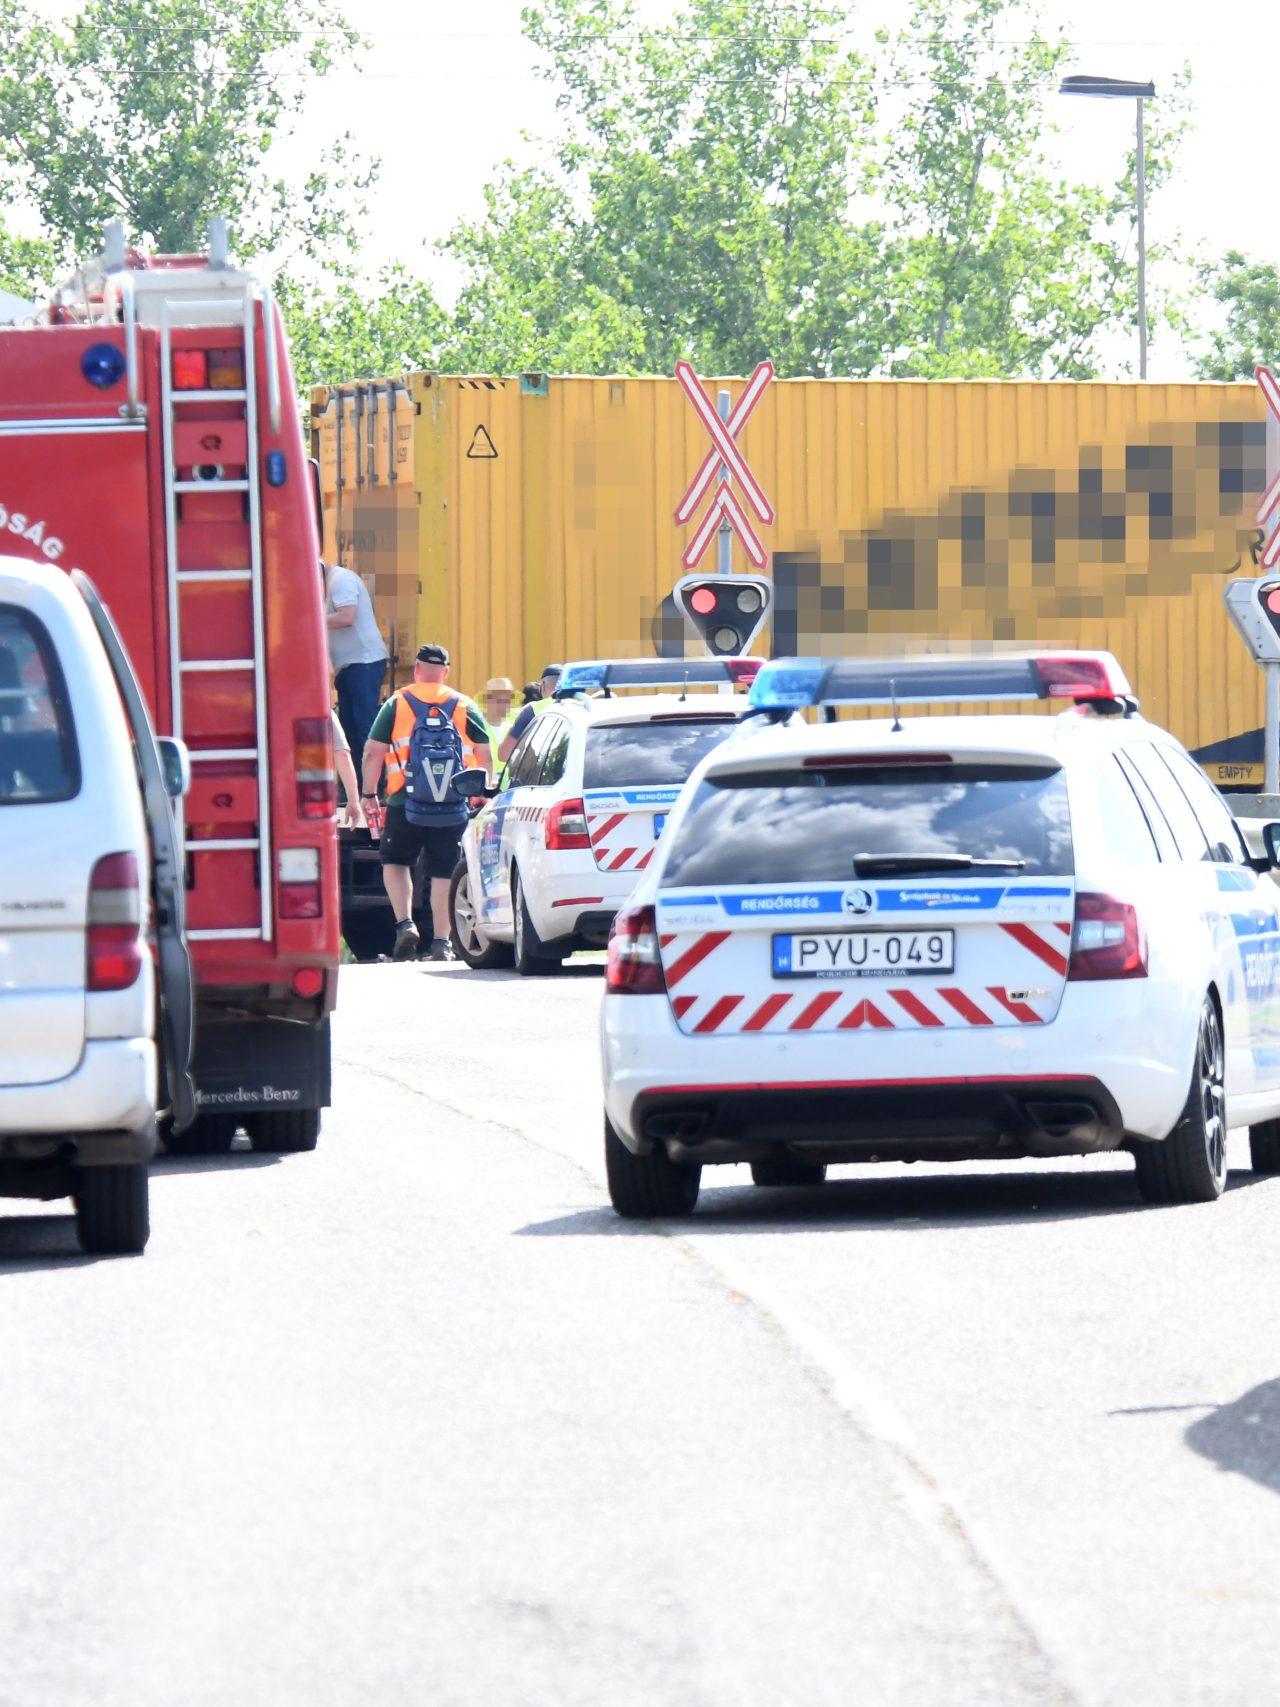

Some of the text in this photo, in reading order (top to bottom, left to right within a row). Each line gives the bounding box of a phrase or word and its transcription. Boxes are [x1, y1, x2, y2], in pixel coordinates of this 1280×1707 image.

[1218, 766, 1253, 779] EMPTY
[741, 895, 819, 911] RENDŐRSÉG
[799, 936, 944, 966] PYU-049
